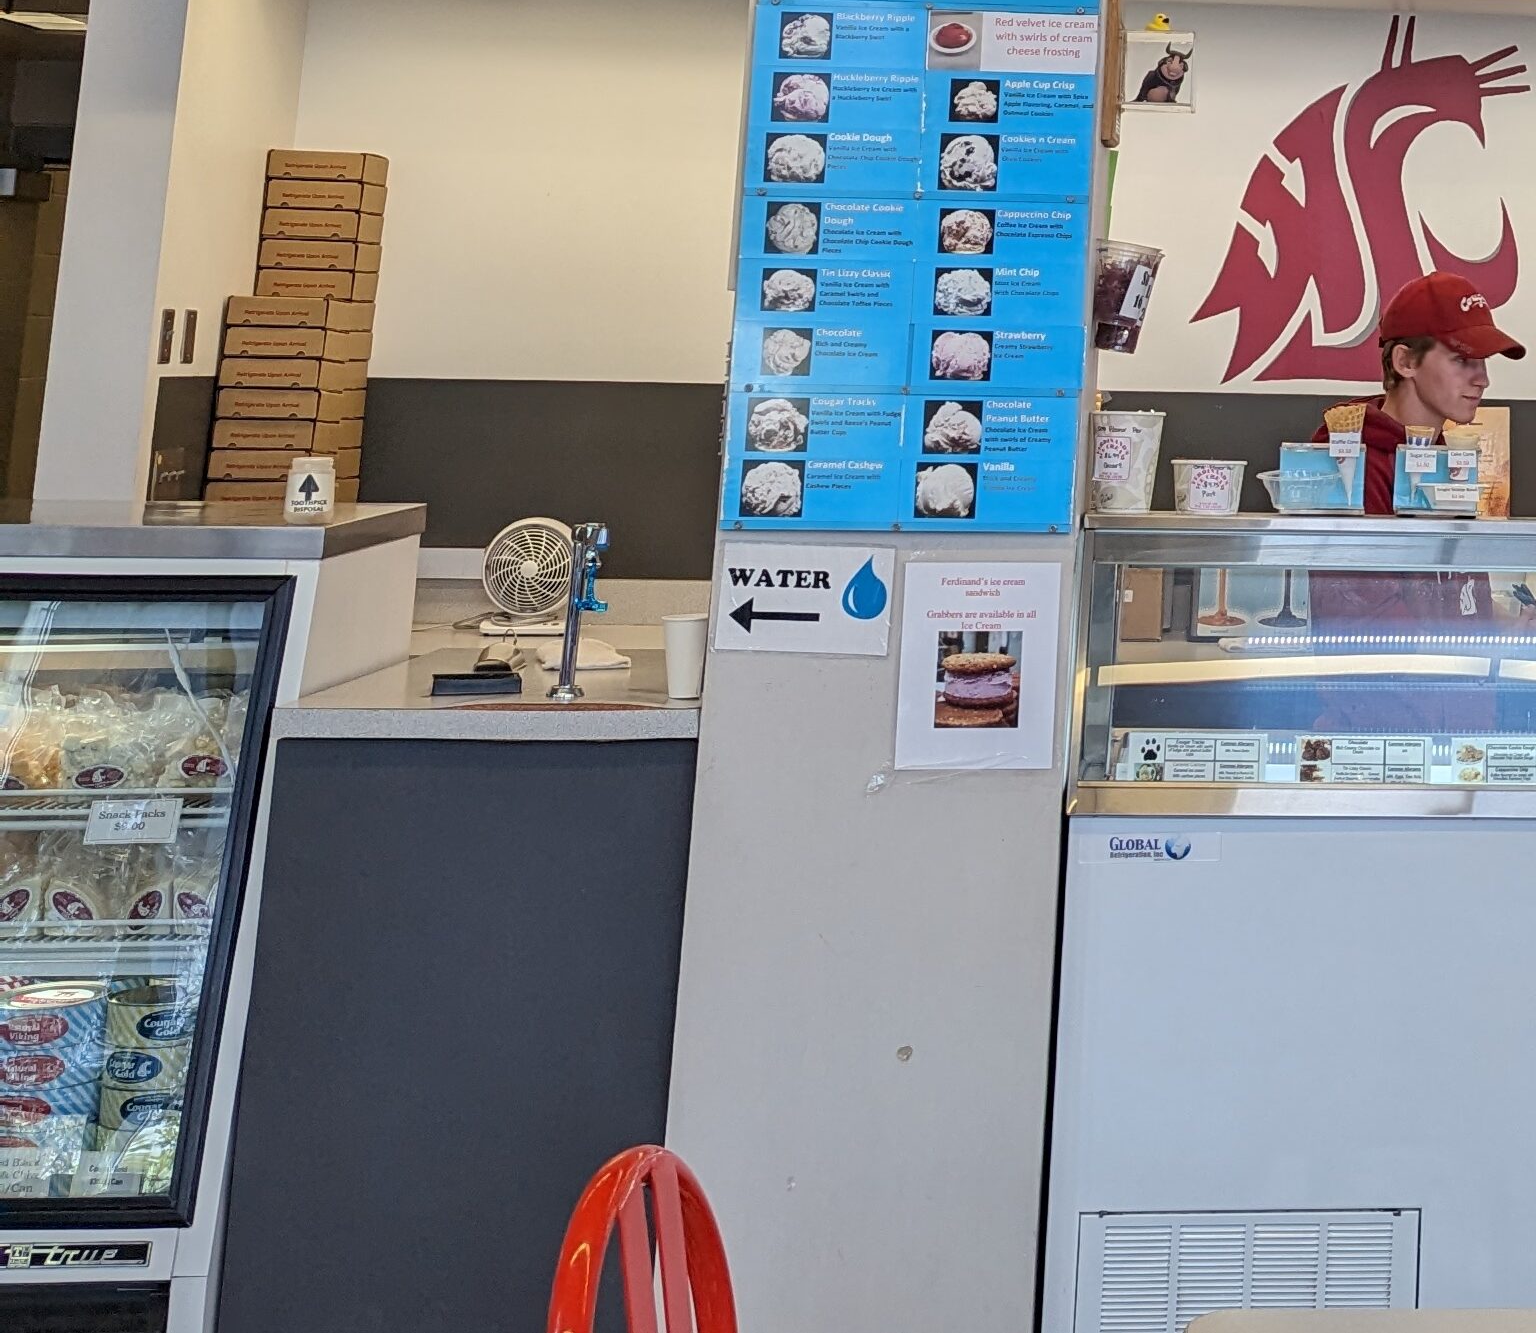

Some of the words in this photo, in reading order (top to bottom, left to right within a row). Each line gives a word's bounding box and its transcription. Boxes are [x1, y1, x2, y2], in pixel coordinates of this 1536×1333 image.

[836, 13, 884, 21] Blackberry
[888, 14, 915, 22] Ripple
[995, 18, 1013, 26] Red
[1016, 18, 1045, 27] velvet
[1049, 19, 1061, 28] ice
[996, 32, 1017, 40] with
[1020, 33, 1047, 42] swirls
[1050, 33, 1060, 42] of
[1007, 47, 1040, 55] cheese
[1043, 47, 1080, 58] frosting
[833, 73, 888, 83] Huckleberry
[1005, 80, 1030, 88] Apple
[1033, 81, 1050, 89] Cup
[1053, 81, 1075, 90] Crisp
[829, 133, 860, 142] Cookie
[863, 134, 892, 143] Dough
[1002, 135, 1037, 144] Cookies
[1047, 136, 1076, 145] Cream
[825, 203, 870, 212] Chocolate
[873, 204, 904, 212] Cookie
[997, 210, 1049, 219] Cappuccino
[1052, 211, 1071, 220] Chip
[824, 217, 854, 225] Dough
[995, 268, 1017, 276] Mint
[1019, 268, 1039, 277] Chip
[816, 328, 863, 337] Chocolate
[995, 331, 1046, 341] Strawberry
[812, 398, 845, 407] Cougar
[848, 398, 876, 406] Tracks
[986, 401, 1031, 409] Chocolate
[986, 415, 1018, 423] Peanut
[1021, 415, 1049, 423] Butter
[808, 461, 846, 470] Caramel
[848, 462, 883, 470] Cashew
[983, 463, 1015, 472] Vanilla
[728, 567, 831, 590] WATER
[941, 577, 988, 586] Ferdinand's
[927, 610, 963, 619] Grabbers
[155, 1027, 180, 1036] Gold
